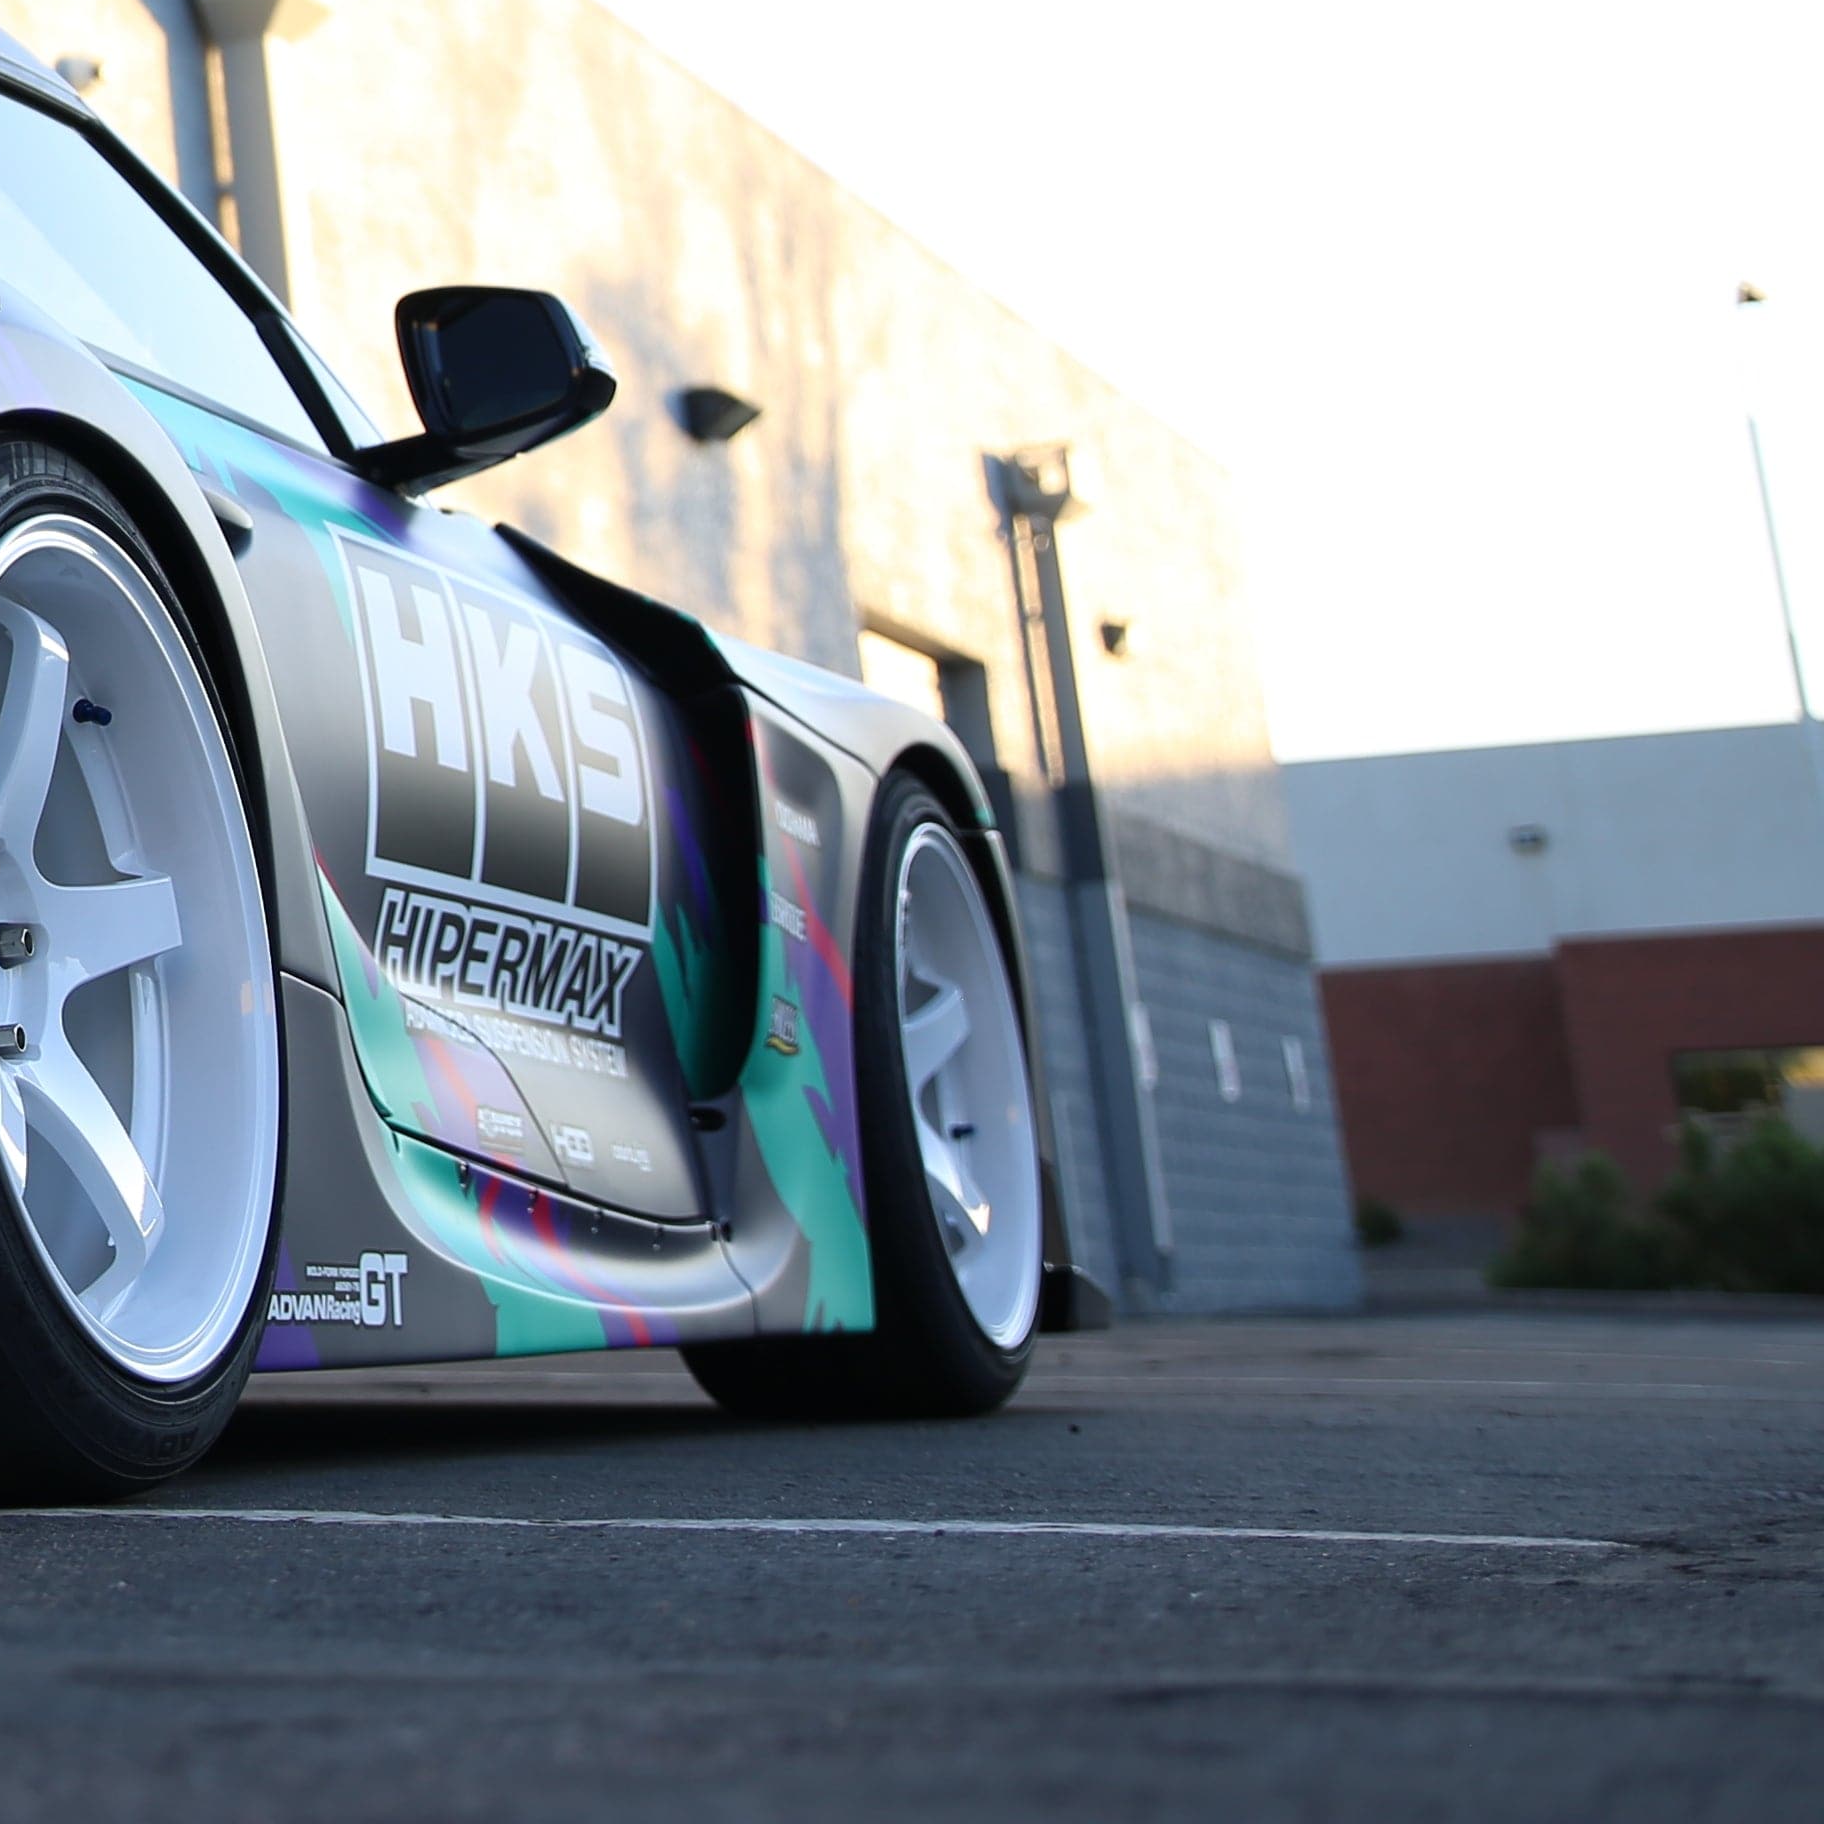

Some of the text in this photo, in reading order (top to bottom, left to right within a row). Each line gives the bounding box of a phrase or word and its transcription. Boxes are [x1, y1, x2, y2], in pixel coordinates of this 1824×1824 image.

[356, 564, 644, 827] HKS
[374, 887, 644, 1038] HIPERMAX
[360, 1252, 408, 1326] GT
